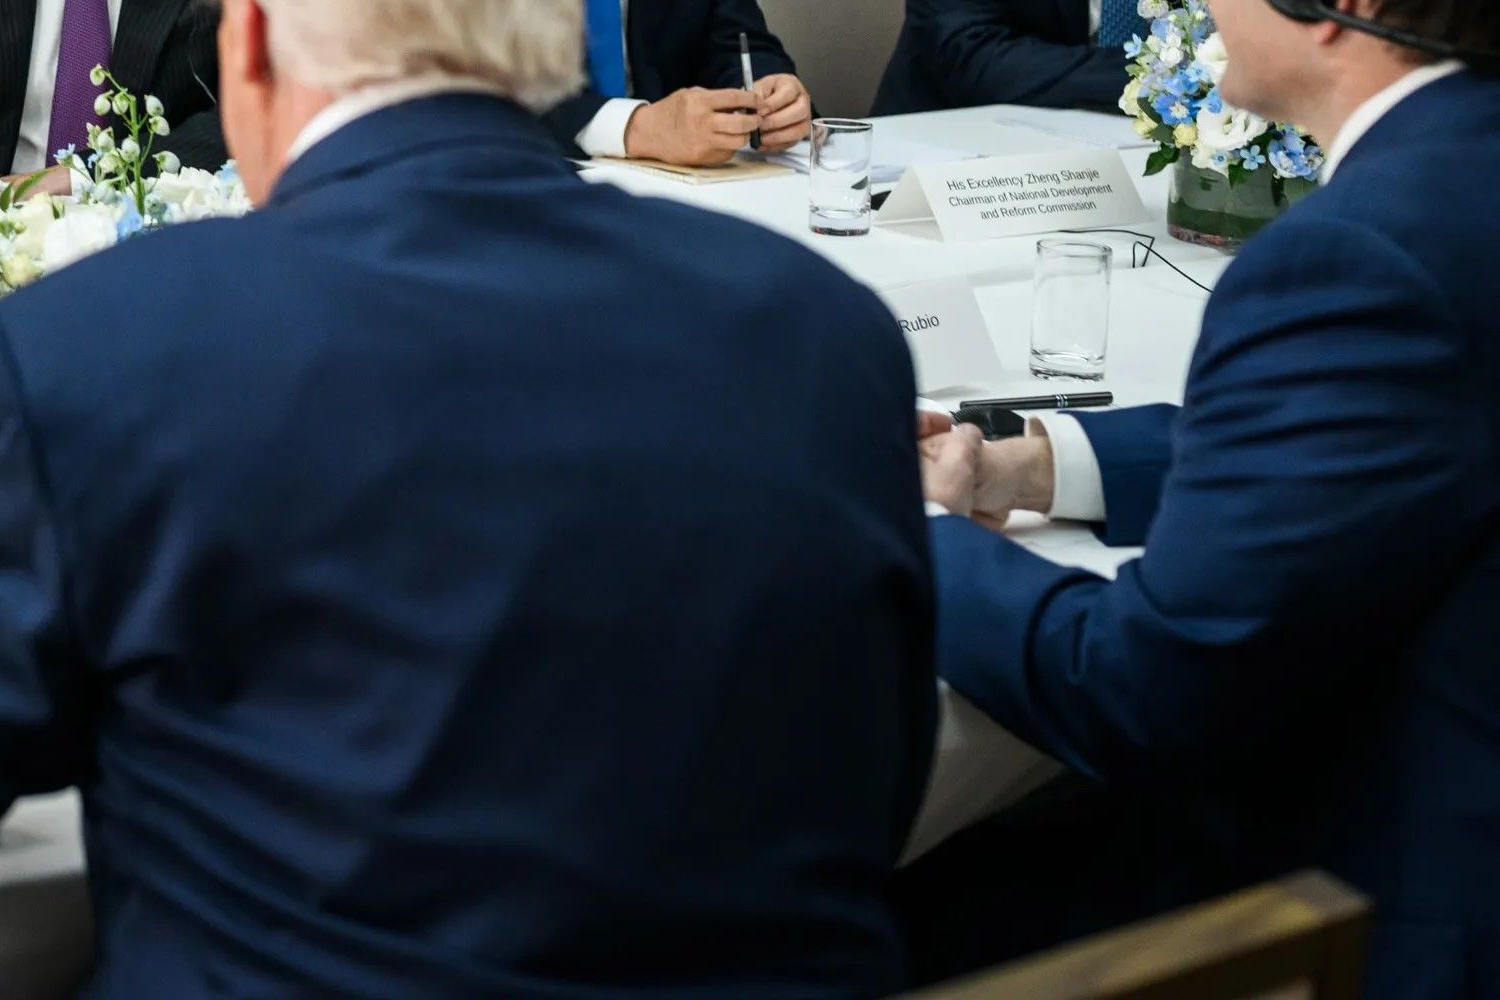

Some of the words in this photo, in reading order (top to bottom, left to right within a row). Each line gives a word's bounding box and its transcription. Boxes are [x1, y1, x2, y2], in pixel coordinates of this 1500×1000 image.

[947, 179, 965, 191] His
[968, 175, 1024, 189] Excellency
[1025, 172, 1061, 185] Zheng
[1061, 168, 1100, 182] Shanjie
[949, 194, 996, 207] Chairman
[1000, 192, 1008, 203] of
[1010, 187, 1049, 202] National
[1051, 183, 1113, 199] Development
[981, 209, 999, 220] and
[1000, 204, 1036, 218] Reform
[1039, 200, 1097, 214] Commission
[898, 313, 940, 334] Rubio
